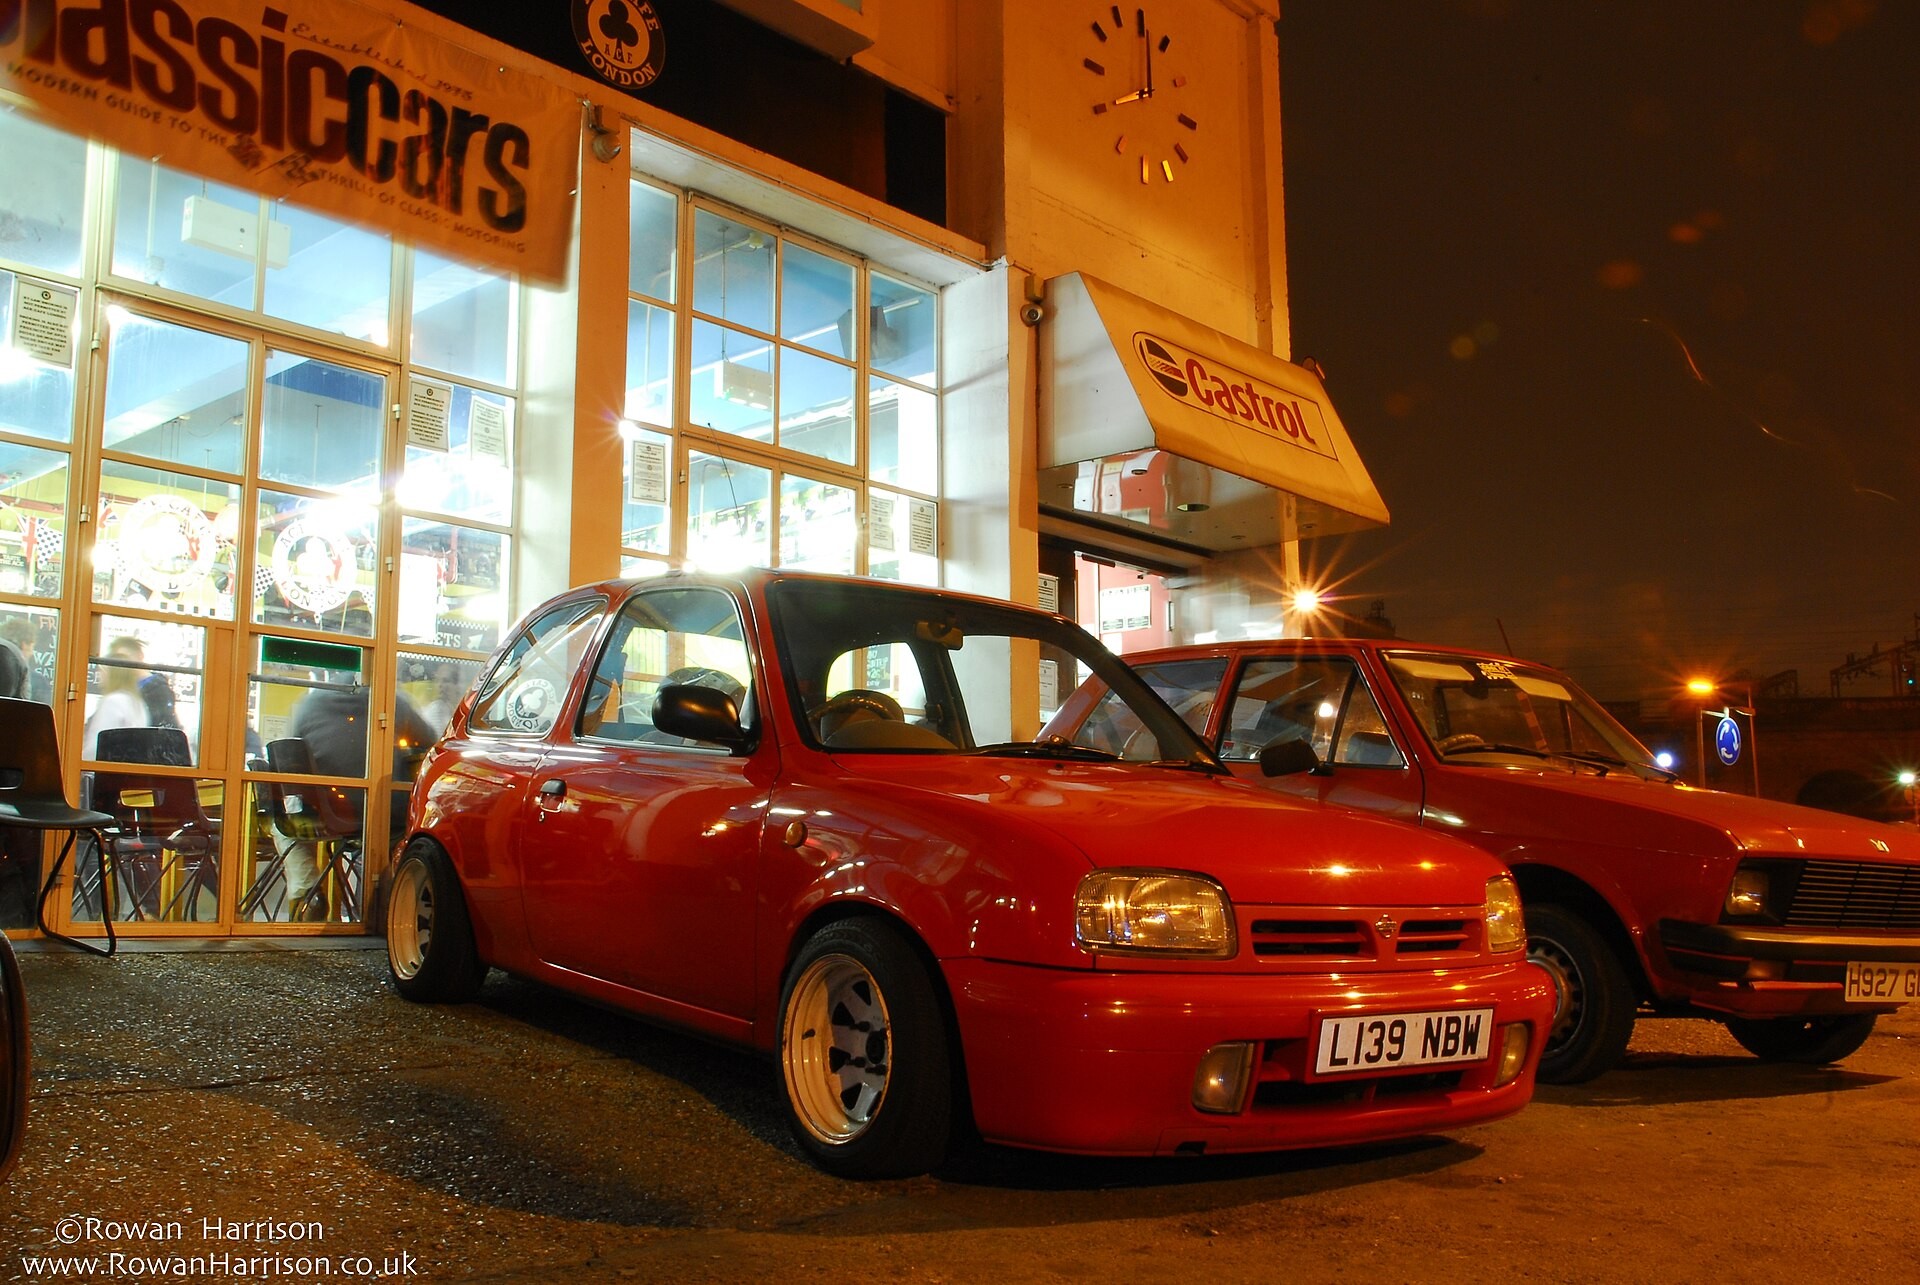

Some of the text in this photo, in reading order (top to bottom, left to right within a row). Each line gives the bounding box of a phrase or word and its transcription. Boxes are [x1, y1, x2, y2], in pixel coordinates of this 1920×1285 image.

[581, 38, 656, 86] LONDON
[604, 44, 633, 64] ACE
[106, 94, 162, 125] GUIDE
[168, 116, 192, 134] TO
[199, 127, 228, 147] THE
[379, 191, 398, 206] OF
[453, 223, 527, 254] MOTORING
[1185, 358, 1316, 445] Castrol
[433, 631, 462, 648] ETS
[1848, 963, 1900, 997] H927
[1329, 1014, 1482, 1067] L139 NBW
